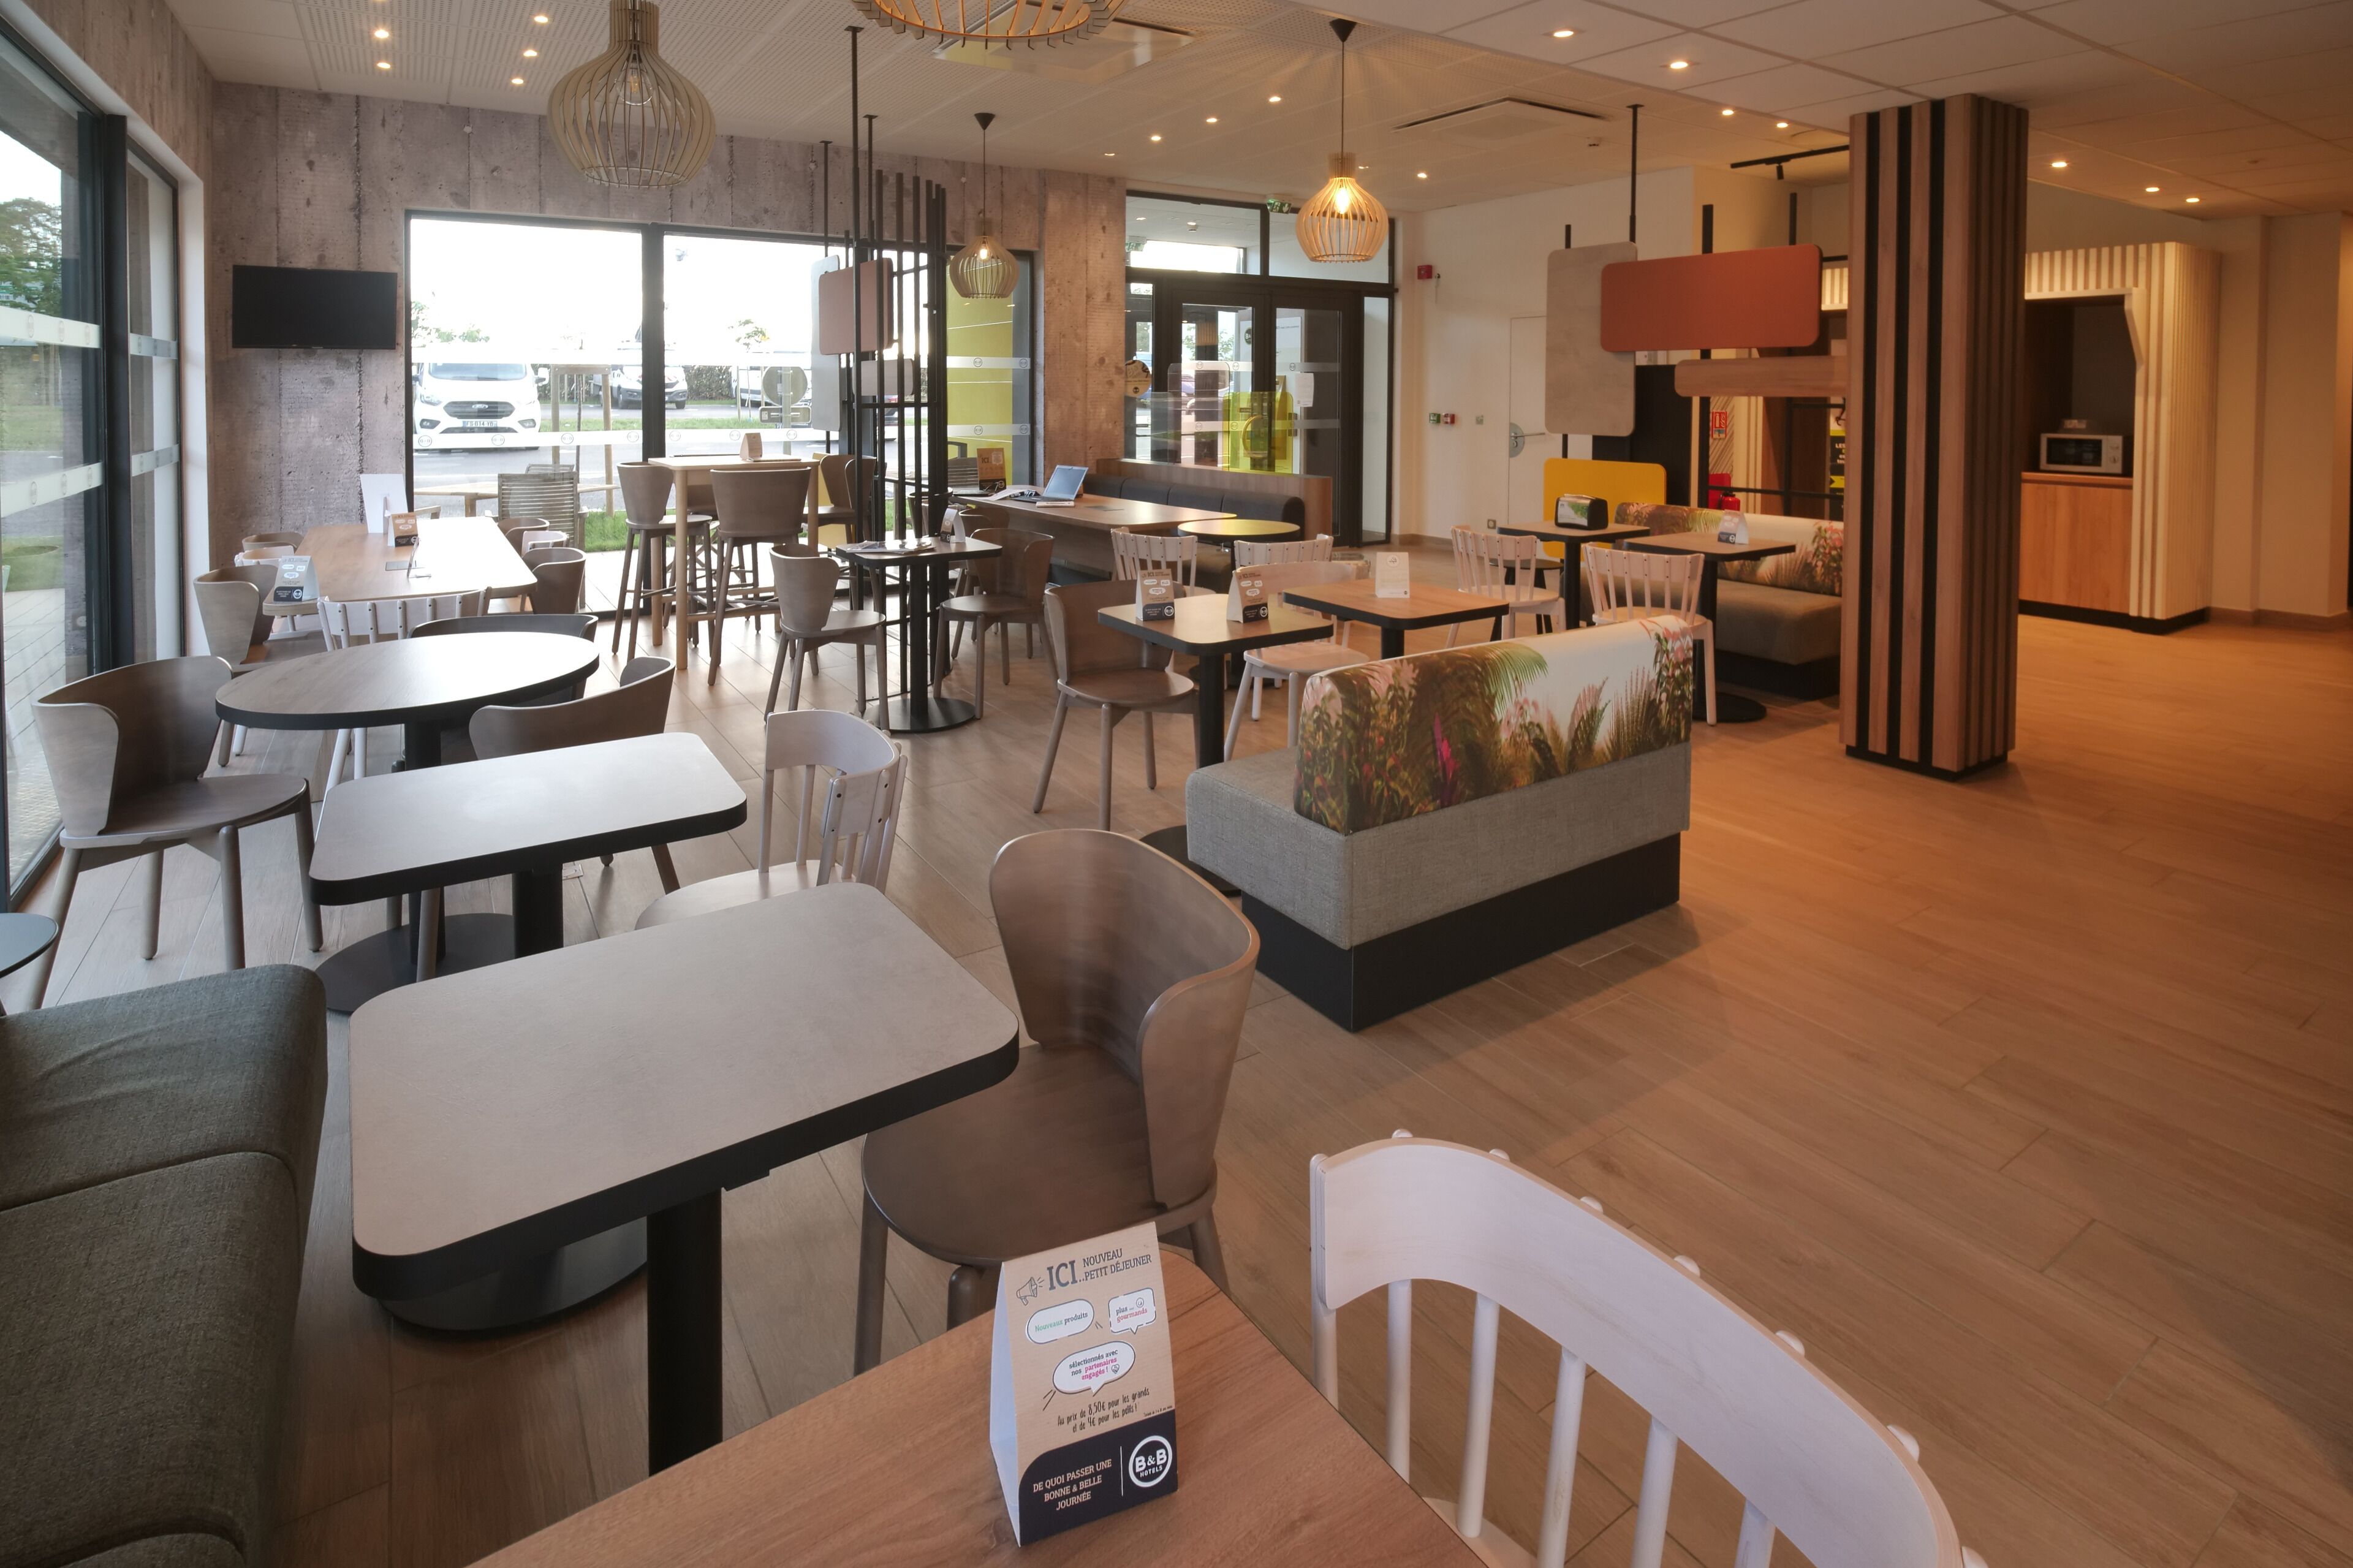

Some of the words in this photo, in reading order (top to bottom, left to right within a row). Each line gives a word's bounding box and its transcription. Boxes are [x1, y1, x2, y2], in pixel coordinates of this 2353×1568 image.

[1083, 1248, 1123, 1267] NOUVEAU
[1110, 1254, 1152, 1274] DÉJEUNER
[1047, 1260, 1078, 1290] ICI
[1116, 1306, 1127, 1316] plus
[1116, 1307, 1148, 1323] gourmands
[1035, 1320, 1063, 1333] Nouveaux
[1064, 1311, 1088, 1325] produits
[1069, 1354, 1104, 1369] sélectionnés
[1105, 1349, 1118, 1358] avec
[1085, 1357, 1117, 1373] partenaires
[1058, 1415, 1064, 1426] Au
[1067, 1413, 1077, 1425] prix
[1080, 1409, 1086, 1418] de
[1088, 1401, 1105, 1416] 8,50€
[1108, 1399, 1120, 1410] pour
[1132, 1387, 1150, 1400] grands
[1079, 1422, 1085, 1431] de
[1088, 1418, 1096, 1426] 4€
[1098, 1415, 1109, 1425] pour
[1135, 1449, 1167, 1472] B&B
[1033, 1482, 1044, 1493] DE
[1045, 1475, 1065, 1490] QUOI
[1066, 1465, 1095, 1481] PASSER
[1096, 1459, 1112, 1471] UNE
[1140, 1465, 1163, 1477] HOTELS
[1044, 1486, 1071, 1502] BONNE
[1079, 1475, 1102, 1490] BELLE
[1056, 1491, 1091, 1511] JOURNÉE
